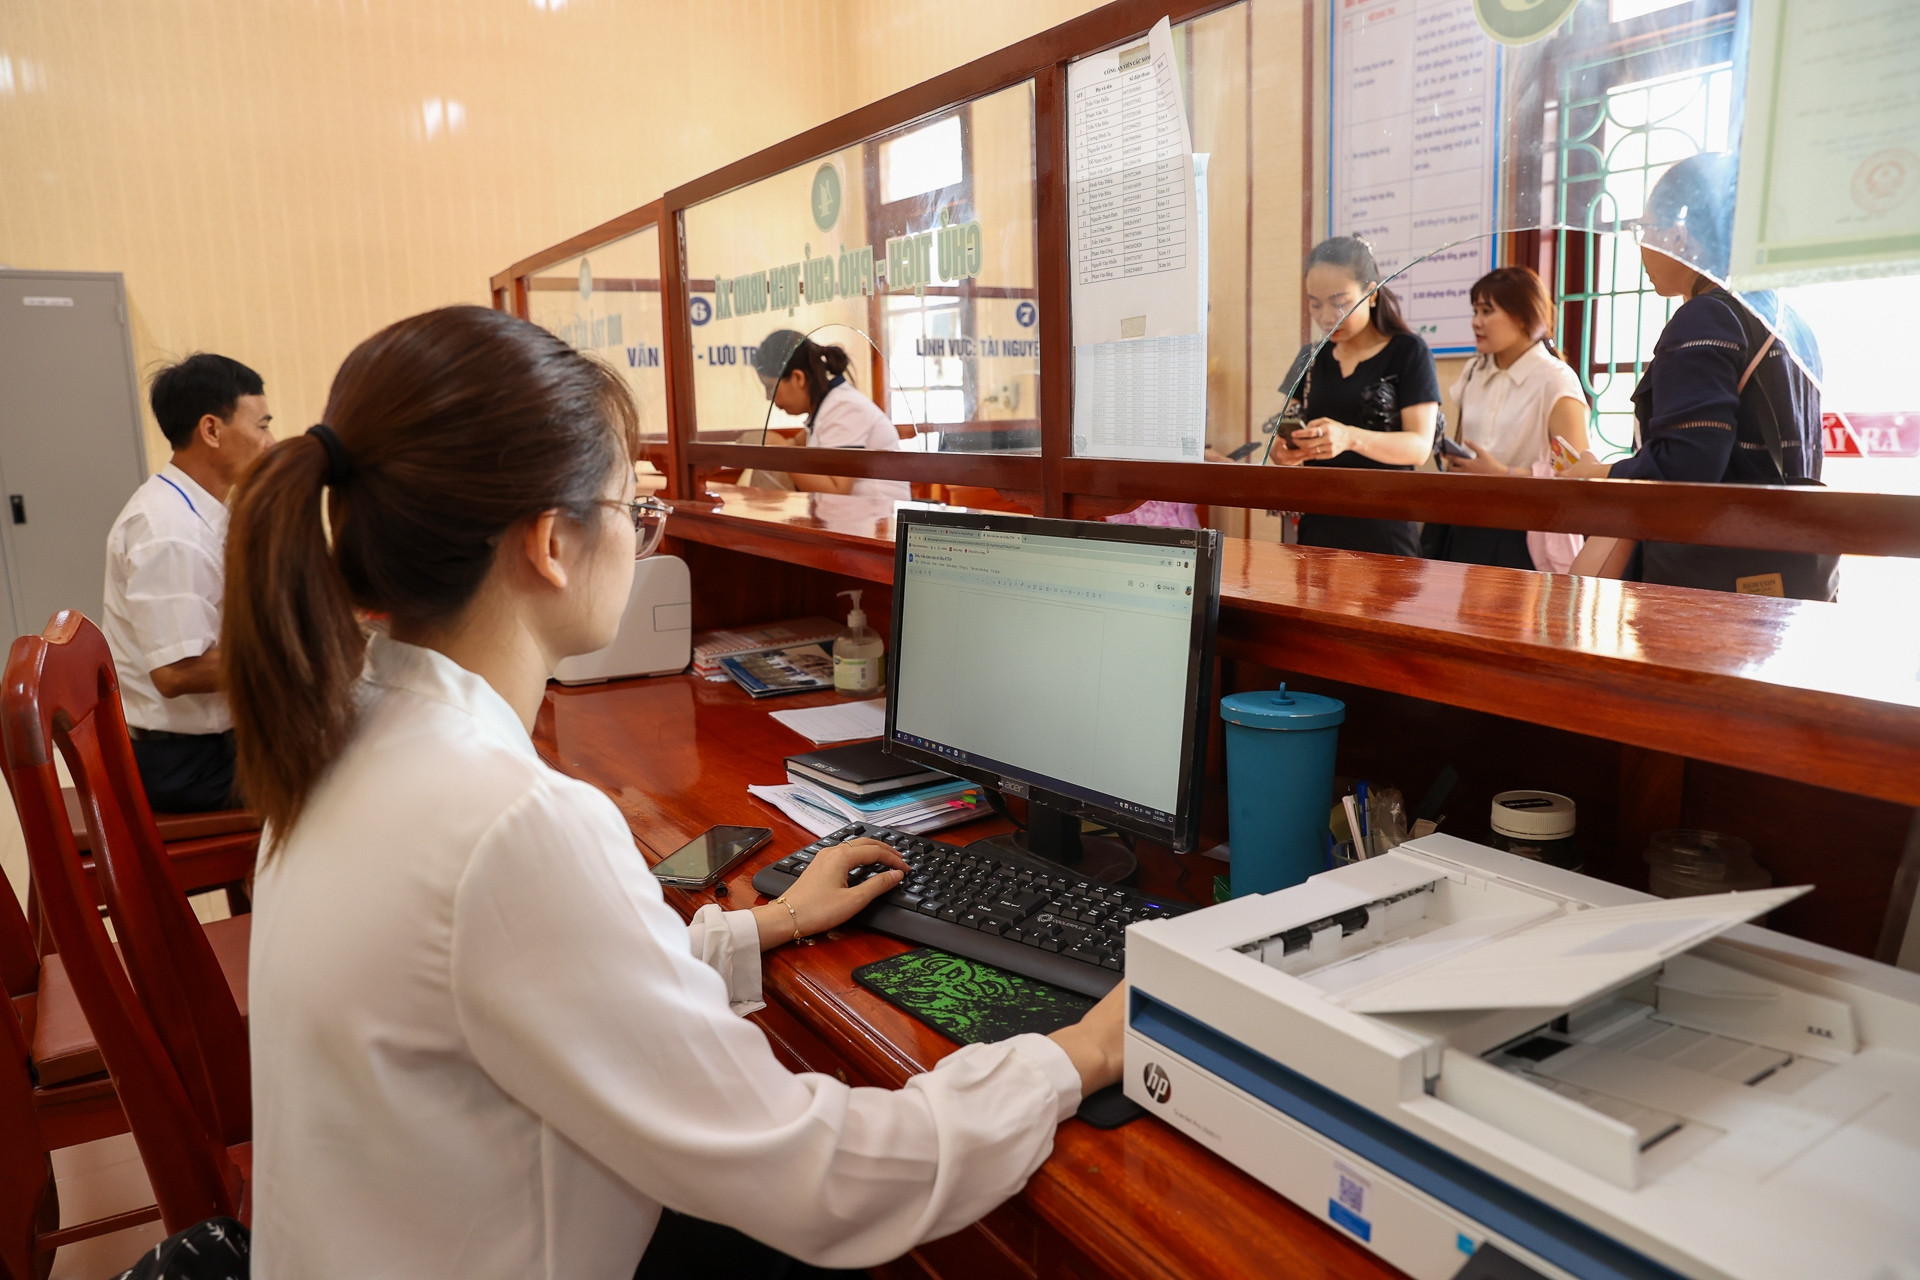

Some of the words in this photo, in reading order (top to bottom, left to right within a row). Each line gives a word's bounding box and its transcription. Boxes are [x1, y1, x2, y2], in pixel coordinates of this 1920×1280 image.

[1020, 306, 1032, 324] 7
[627, 343, 659, 367] VĂN
[980, 336, 999, 356] TÀI
[1004, 780, 1024, 792] acer
[1147, 1063, 1168, 1100] hp
